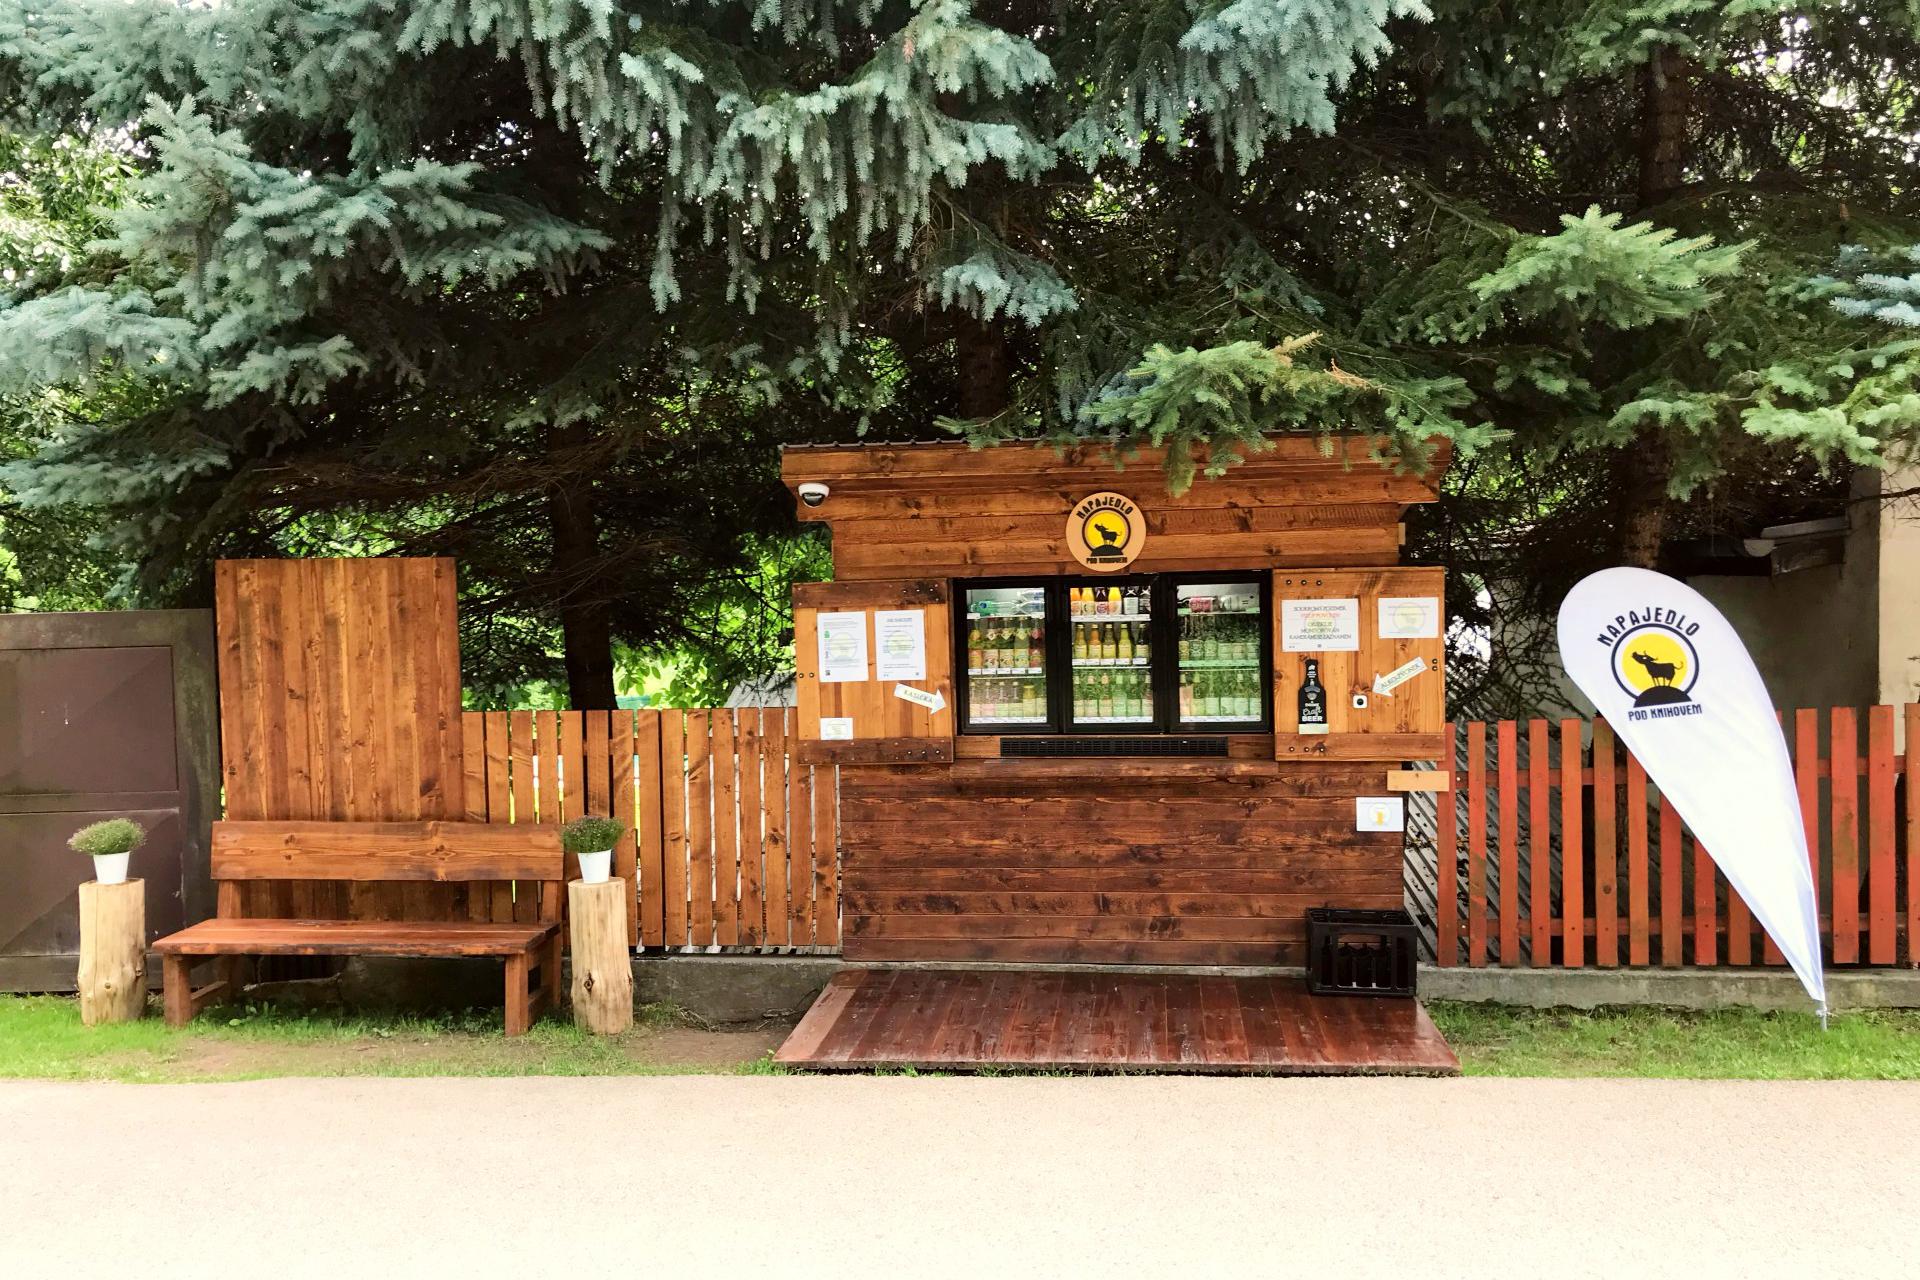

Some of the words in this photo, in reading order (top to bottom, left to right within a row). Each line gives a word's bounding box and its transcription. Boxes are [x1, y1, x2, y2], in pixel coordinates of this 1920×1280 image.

[1076, 496, 1133, 519] NAPAJEDLO
[1597, 606, 1700, 647] NAPAJEDLO
[1628, 709, 1648, 721] POD
[1650, 704, 1702, 719] KNIHOVEM
